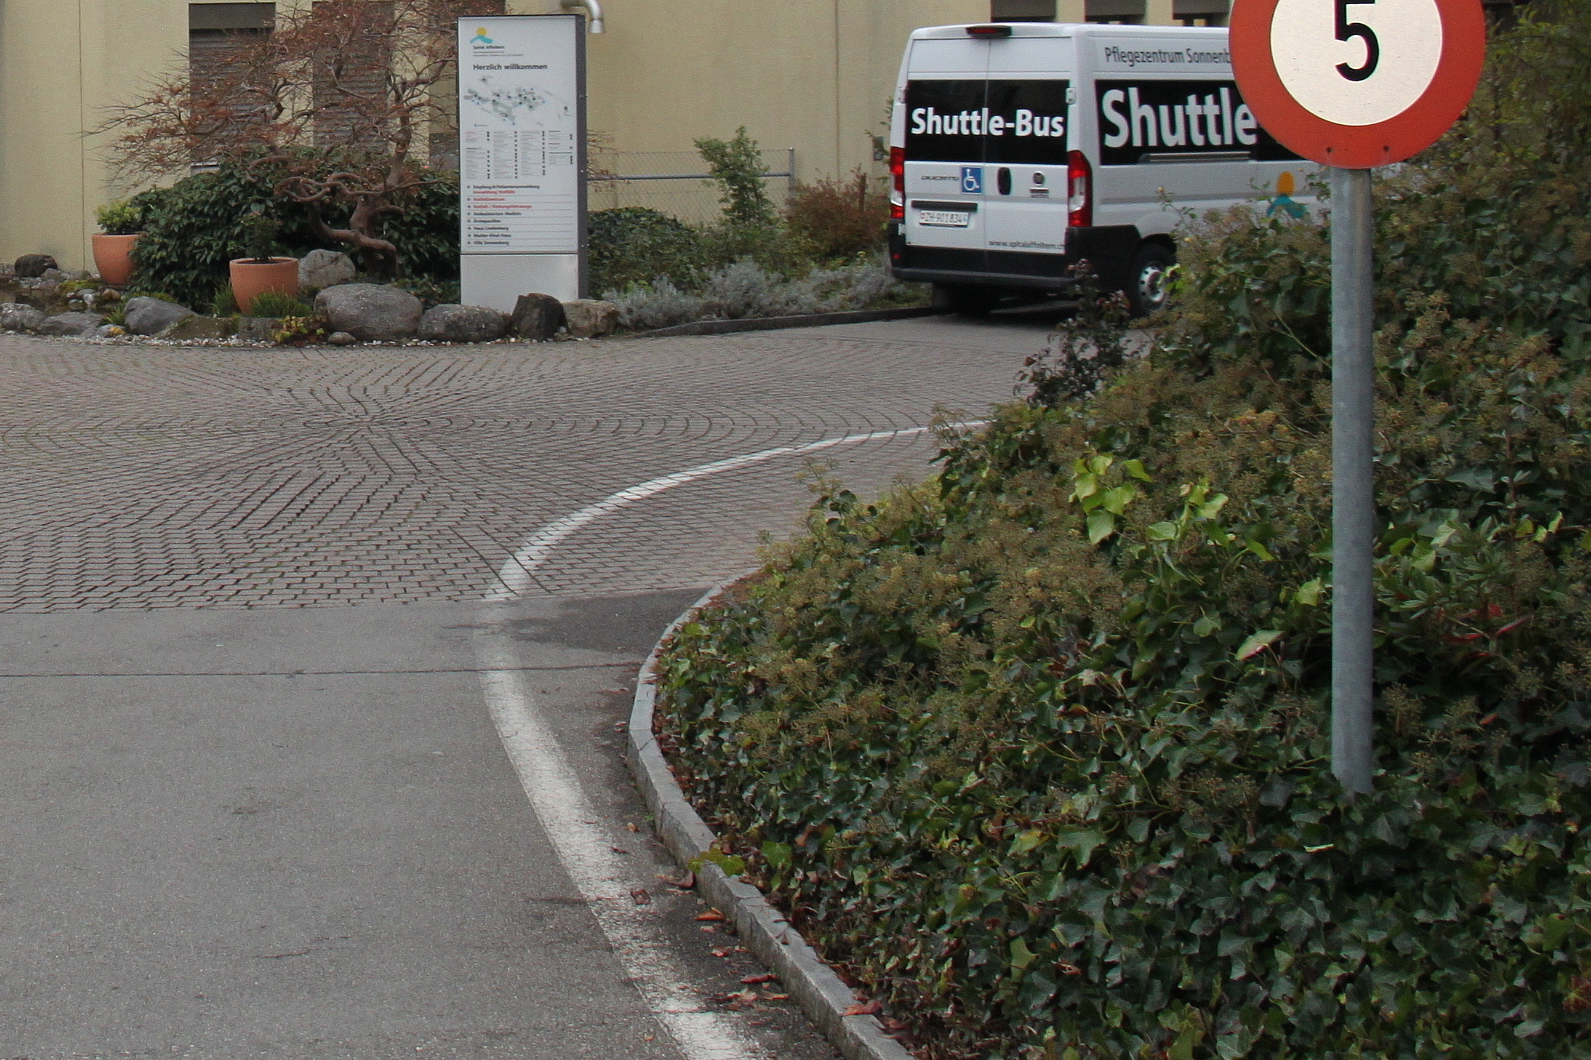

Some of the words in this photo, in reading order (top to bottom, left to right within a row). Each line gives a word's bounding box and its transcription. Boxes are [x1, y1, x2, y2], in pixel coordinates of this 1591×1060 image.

[472, 62, 503, 71] Herzlich
[504, 62, 548, 70] willkommen
[1104, 45, 1185, 68] Pflegezentrum
[1186, 47, 1231, 64] Sonnenb
[911, 106, 1065, 138] Shuttle-Bus
